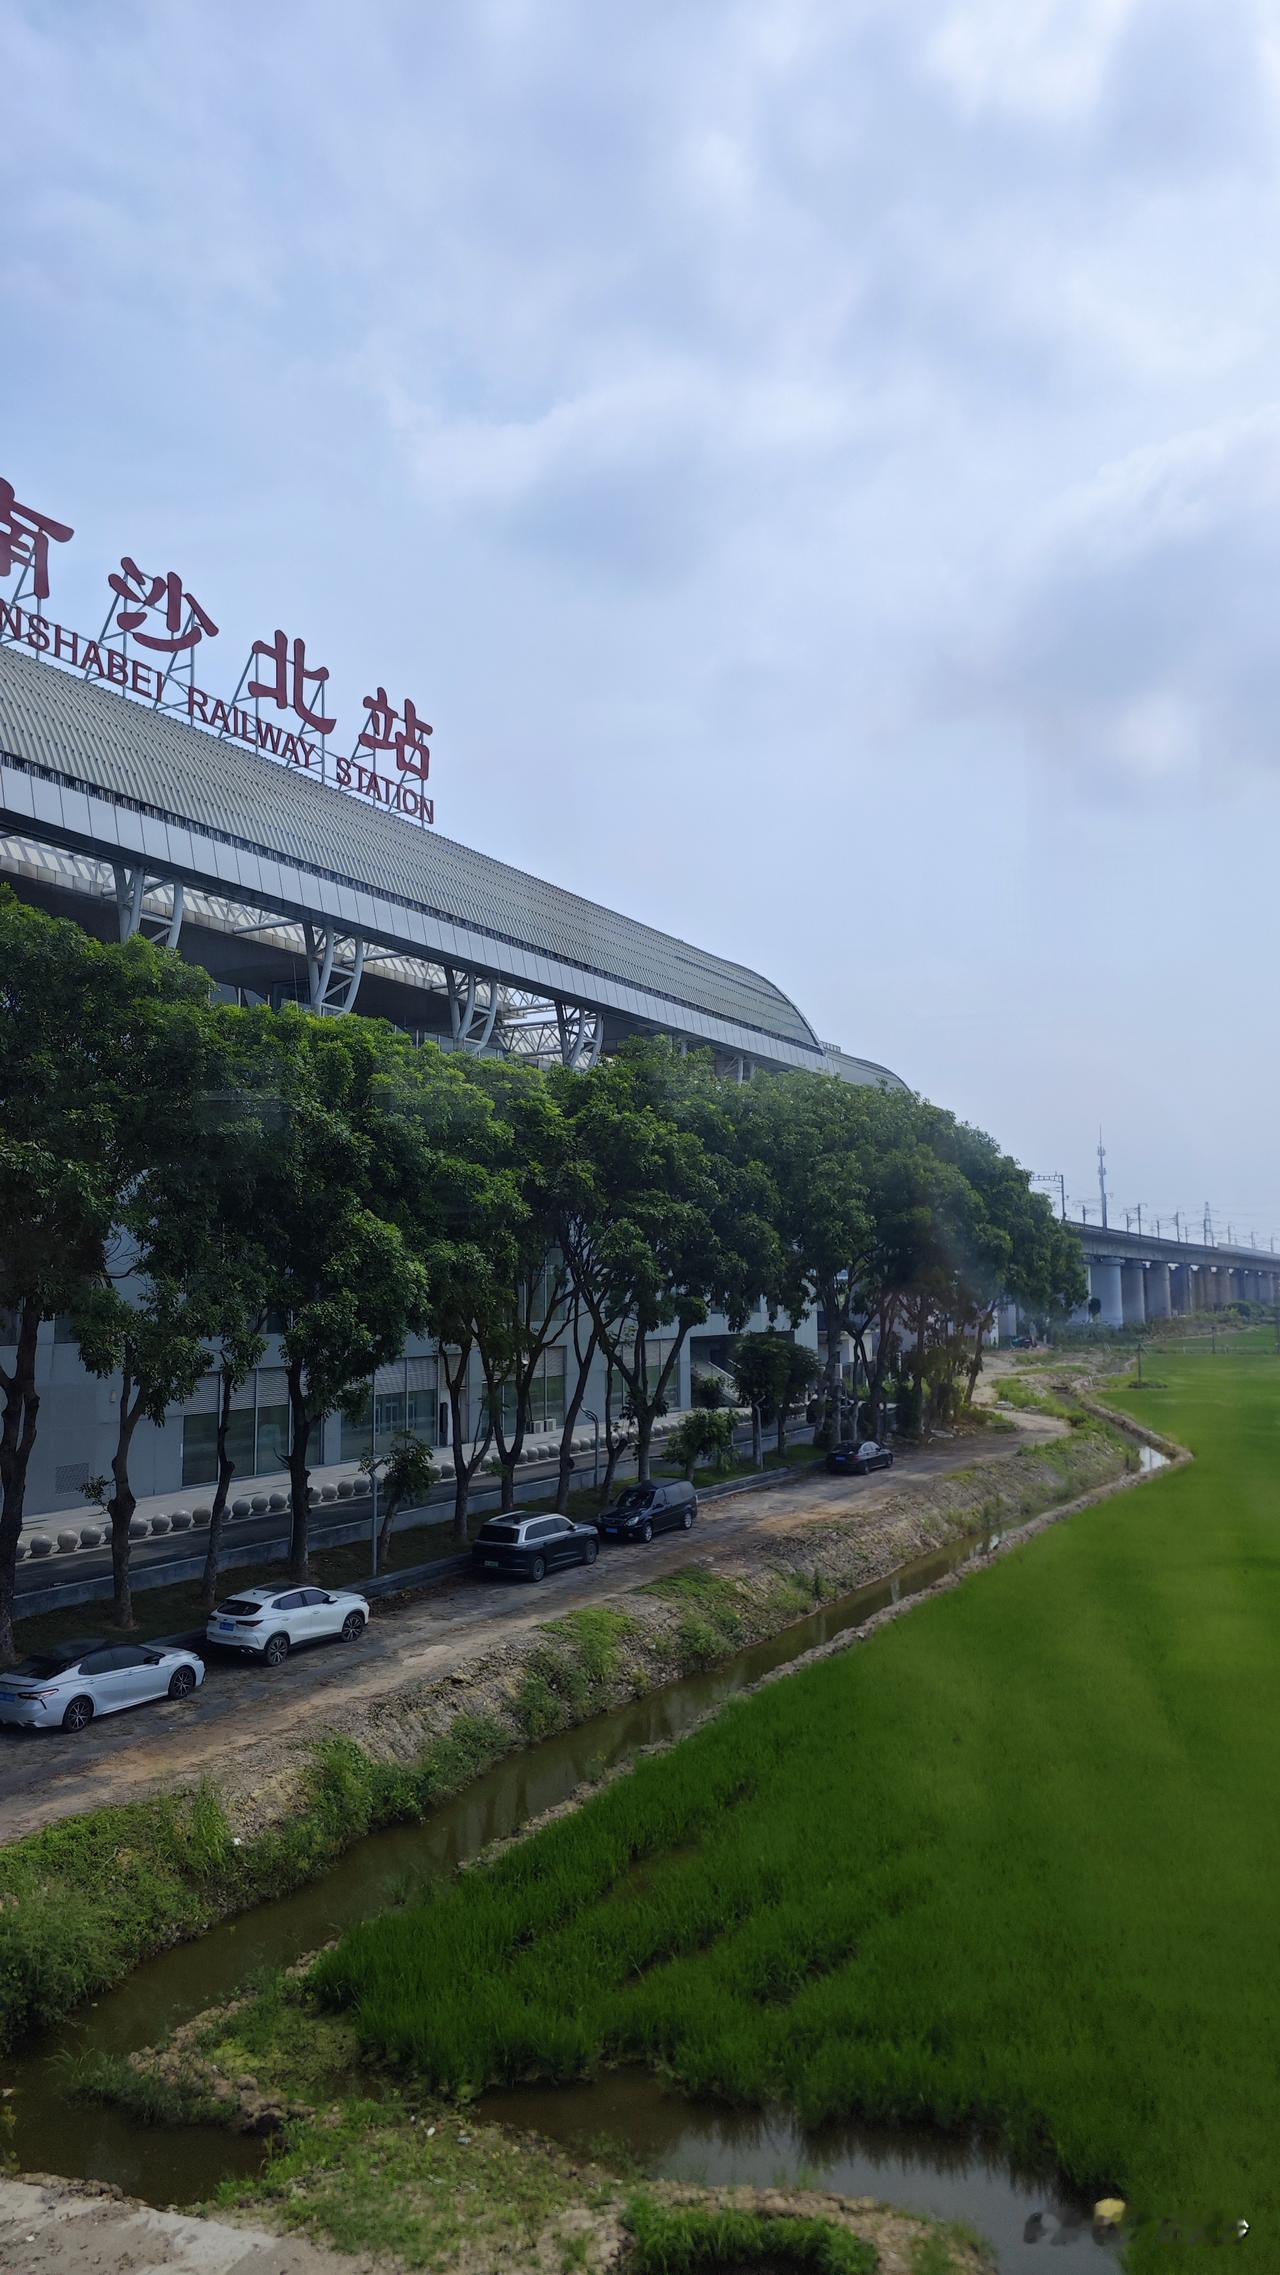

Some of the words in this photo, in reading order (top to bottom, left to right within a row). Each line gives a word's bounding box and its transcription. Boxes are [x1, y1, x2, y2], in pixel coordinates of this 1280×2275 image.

[0, 598, 163, 702] NSHABEI
[187, 686, 316, 769] RAILWAY
[336, 757, 434, 824] STATION
